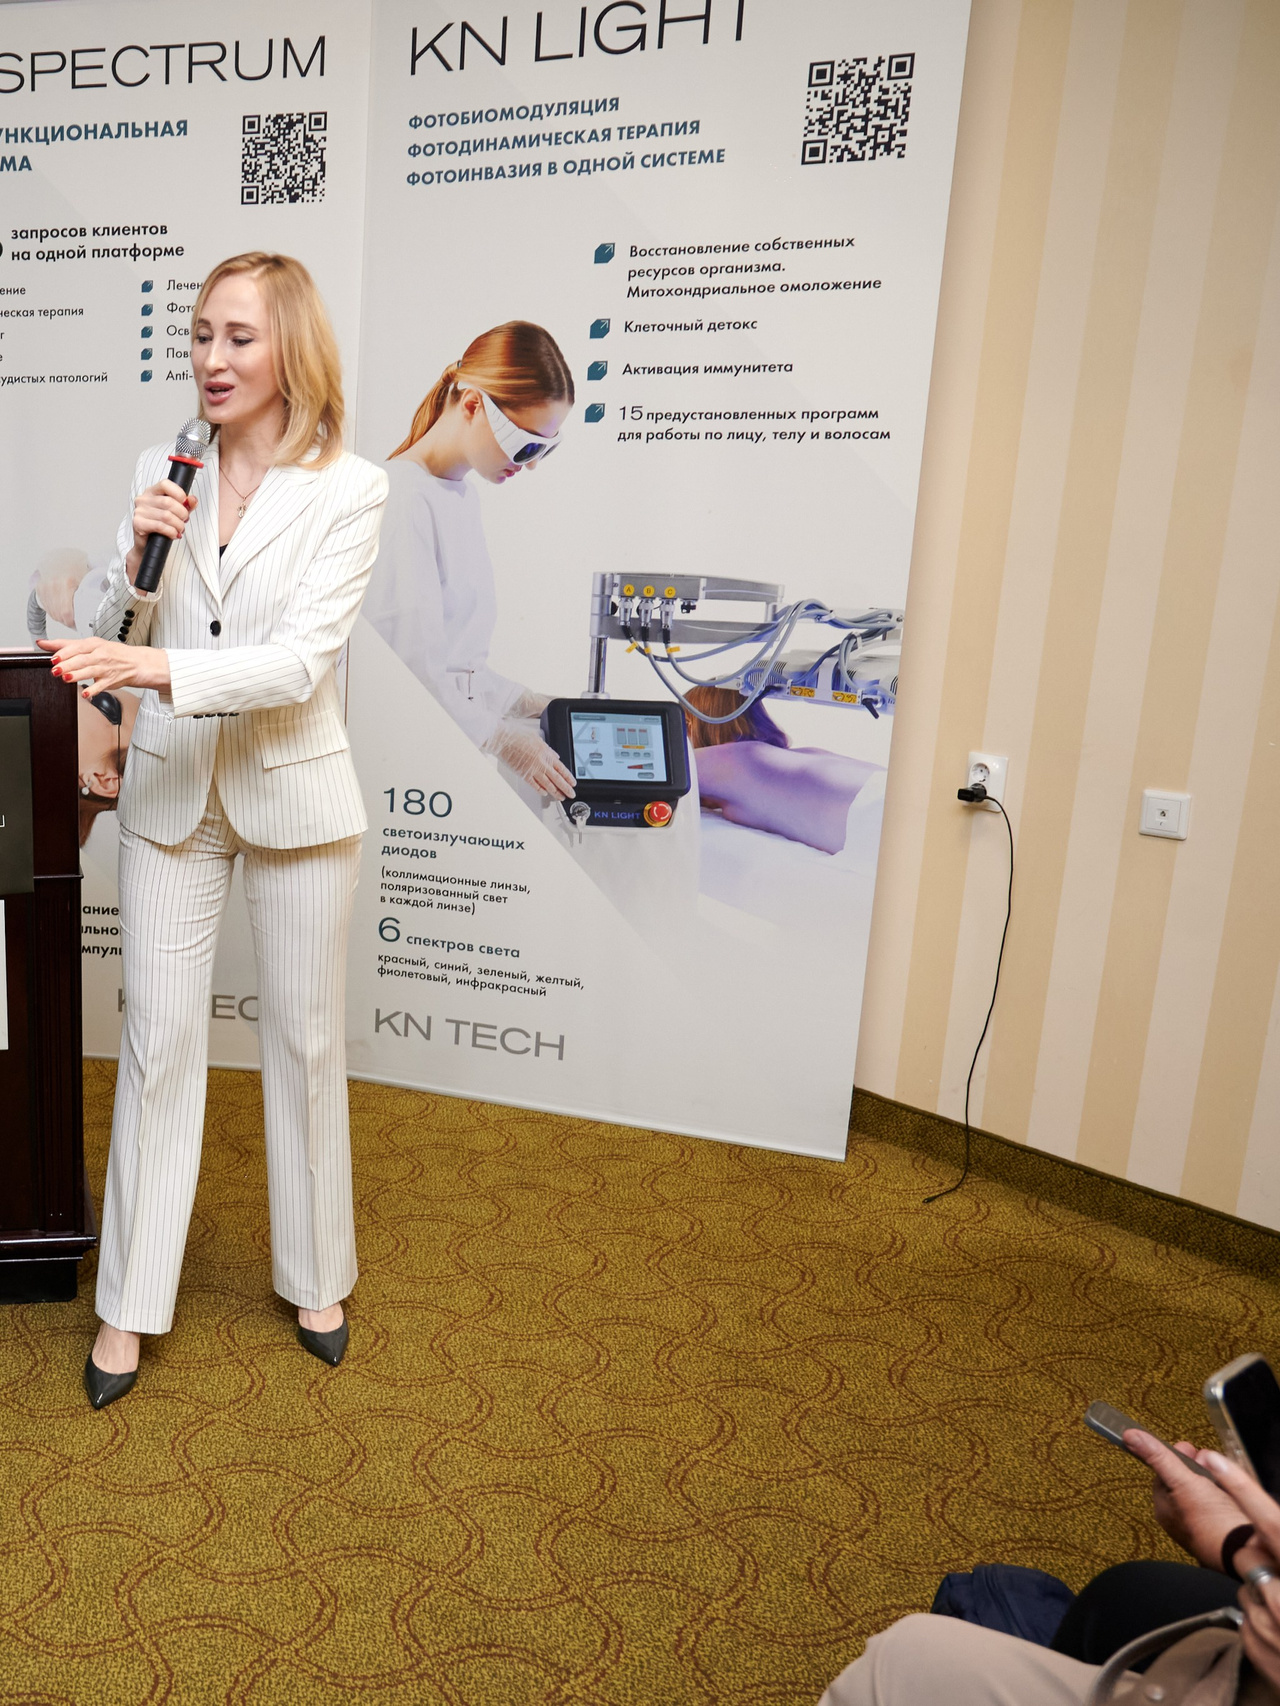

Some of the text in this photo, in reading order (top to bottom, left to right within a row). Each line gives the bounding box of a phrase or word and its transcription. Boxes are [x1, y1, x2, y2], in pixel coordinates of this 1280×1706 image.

[411, 16, 508, 76] KN
[409, 97, 621, 131] ФОТОБИОМОДУЛЯЦИЯ
[408, 120, 700, 160] ФОТОДИНАМИЧЕСКАЯ ТЕРАПИЯ
[407, 148, 725, 186] ФОТОИНВАЗИЯ В ОДНОЙ СИСТЕМЕ
[11, 225, 168, 243] запросов клиентов
[12, 243, 184, 262] на одной платформе
[630, 237, 855, 257] Восстановление собственных
[628, 263, 785, 282] ресурсов организма.
[167, 279, 204, 292] Лечен
[627, 280, 881, 299] Митохондриальное омоложение
[38, 308, 83, 320] терапия
[166, 324, 190, 337] Осв
[624, 319, 757, 333] Клеточный детокс
[166, 347, 192, 359] Пов
[49, 372, 107, 383] патологий
[622, 363, 793, 377] Активация иммунитета
[619, 406, 878, 424] 15 предустановленных программ
[617, 427, 890, 443] для работы по лицу, телу и волосам
[384, 787, 452, 818] 180
[594, 811, 641, 820] KN LIGHT
[382, 828, 525, 851] светоизлучающих
[381, 846, 437, 859] диодов
[381, 866, 530, 894] (коллимационные линзы,
[380, 882, 508, 903] поляризованный свет
[80, 904, 120, 917] ание
[390, 897, 433, 908] каждой
[437, 902, 475, 915] линзе)
[379, 917, 519, 958] 6 спектров света
[377, 955, 584, 990] красный, синий, зеленый, желтый,
[377, 965, 546, 996] фиолетовый, инфракрасный
[375, 1008, 564, 1061] KN TECH
